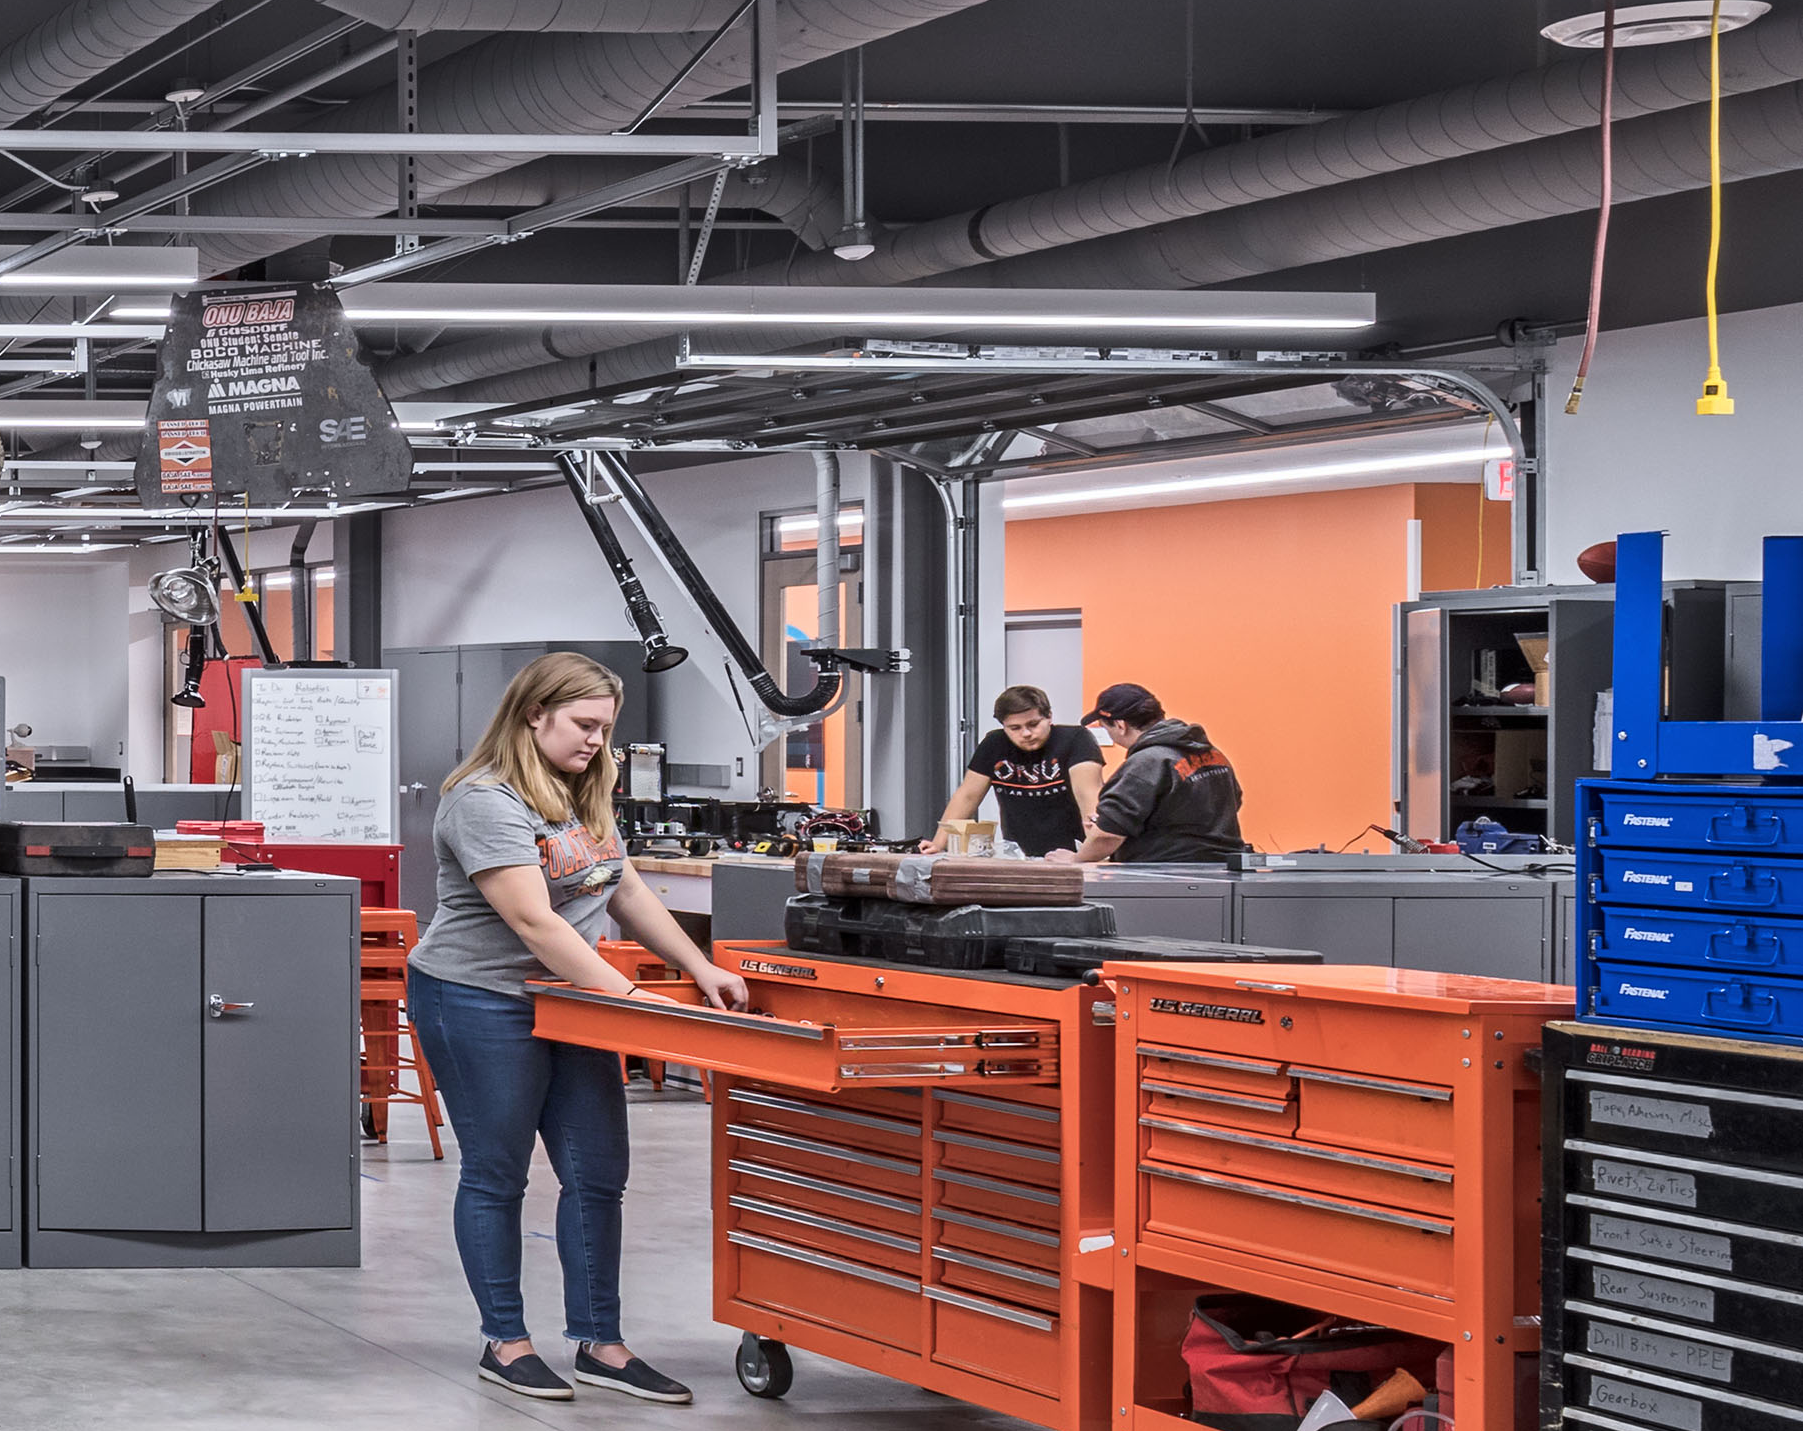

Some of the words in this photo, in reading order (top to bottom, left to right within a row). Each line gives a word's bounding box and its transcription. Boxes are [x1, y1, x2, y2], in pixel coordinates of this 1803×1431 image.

[204, 304, 243, 327] ONU
[244, 300, 293, 324] BAJA
[200, 338, 219, 348] ONU
[222, 335, 261, 347] Student
[263, 331, 298, 342] Senate
[246, 339, 322, 355] MACHINE
[187, 359, 231, 372] Chickasaw
[233, 355, 269, 368] Machine
[271, 353, 287, 363] and
[290, 350, 309, 361] Tool
[311, 349, 329, 361] Inc.
[210, 369, 239, 379] Husky
[241, 365, 263, 376] Lima
[265, 362, 306, 374] Refinery
[228, 376, 301, 396] MAGNA
[208, 403, 241, 415] MAGNA
[243, 397, 303, 412] POWERTRAIN
[319, 416, 367, 442] SAE
[759, 962, 817, 980] GENERAL
[1178, 1000, 1264, 1025] GENERAL
[1595, 1222, 1631, 1240] Front
[1600, 1273, 1628, 1295] Rear
[1637, 1281, 1707, 1310] Suspension
[1593, 1329, 1624, 1350] Drill
[1630, 1337, 1658, 1355] Bits
[1595, 1383, 1658, 1414] Gearbox
